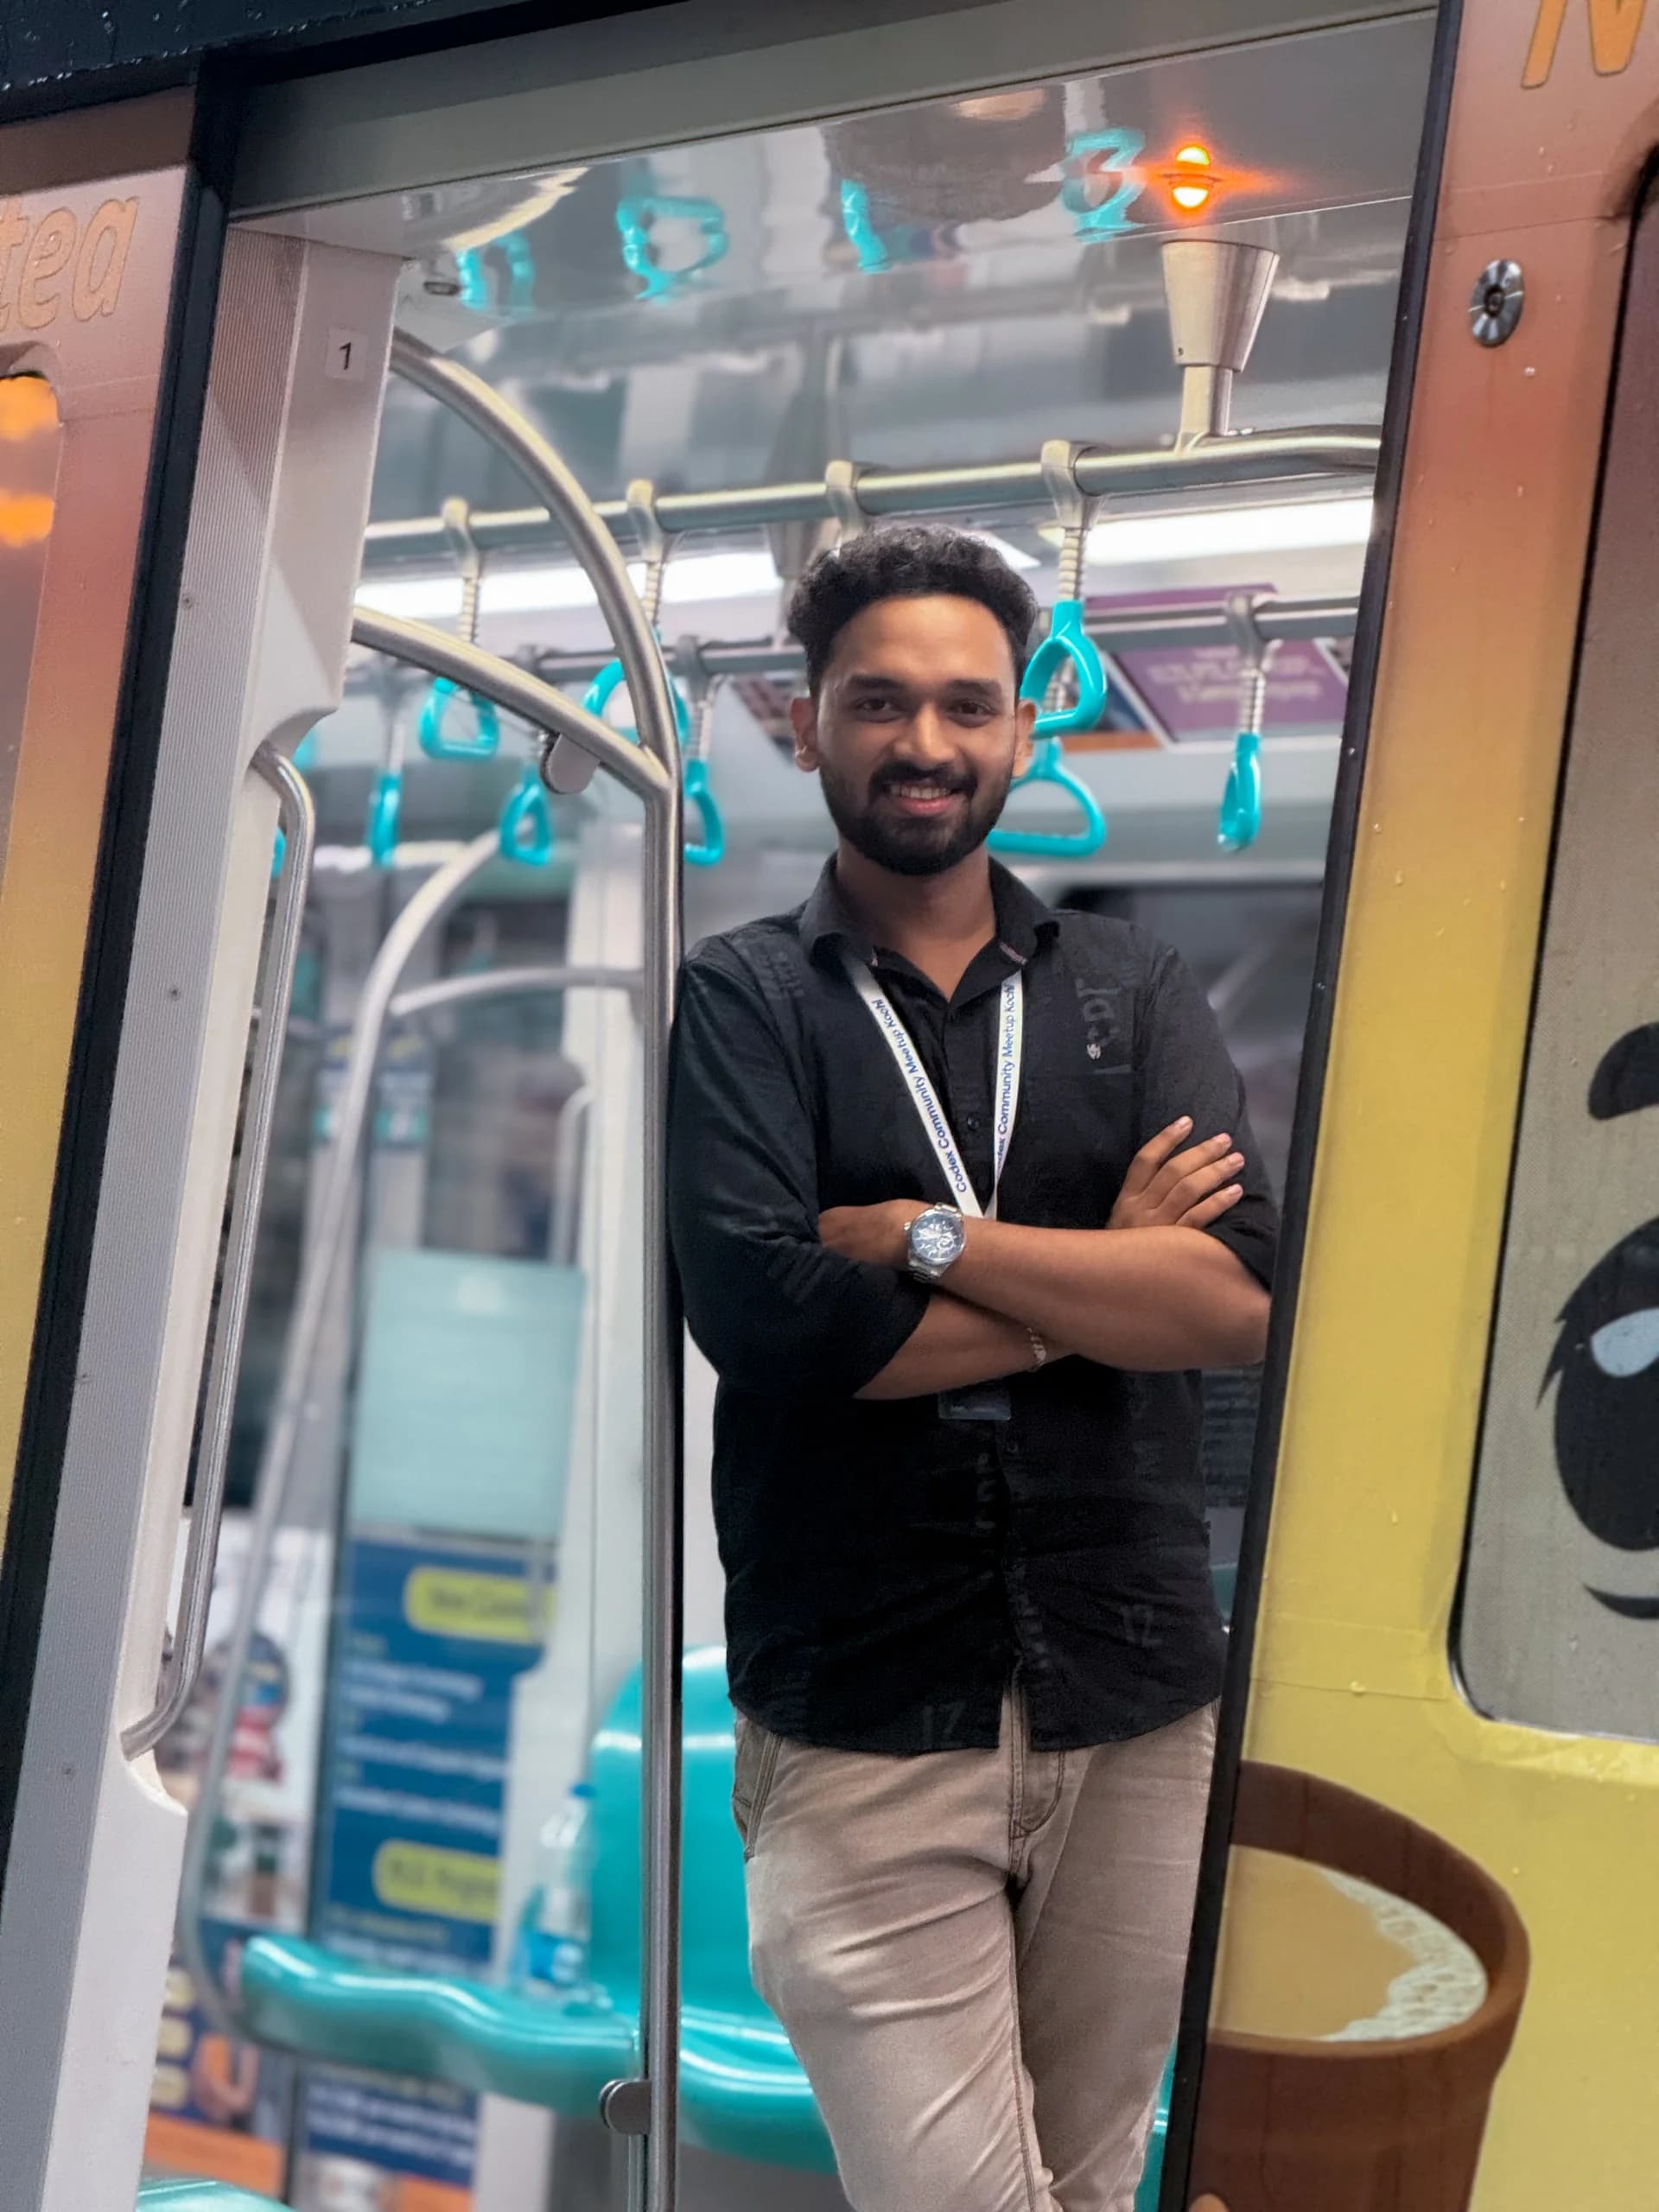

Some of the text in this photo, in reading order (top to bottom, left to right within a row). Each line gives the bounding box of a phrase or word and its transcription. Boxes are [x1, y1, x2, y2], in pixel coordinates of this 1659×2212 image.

[339, 342, 351, 370] 1
[893, 1029, 918, 1073] Meetup
[1002, 1015, 1016, 1057] Meetup
[913, 1075, 950, 1149] Community
[998, 1060, 1015, 1135] Community
[945, 1151, 966, 1193] Codex
